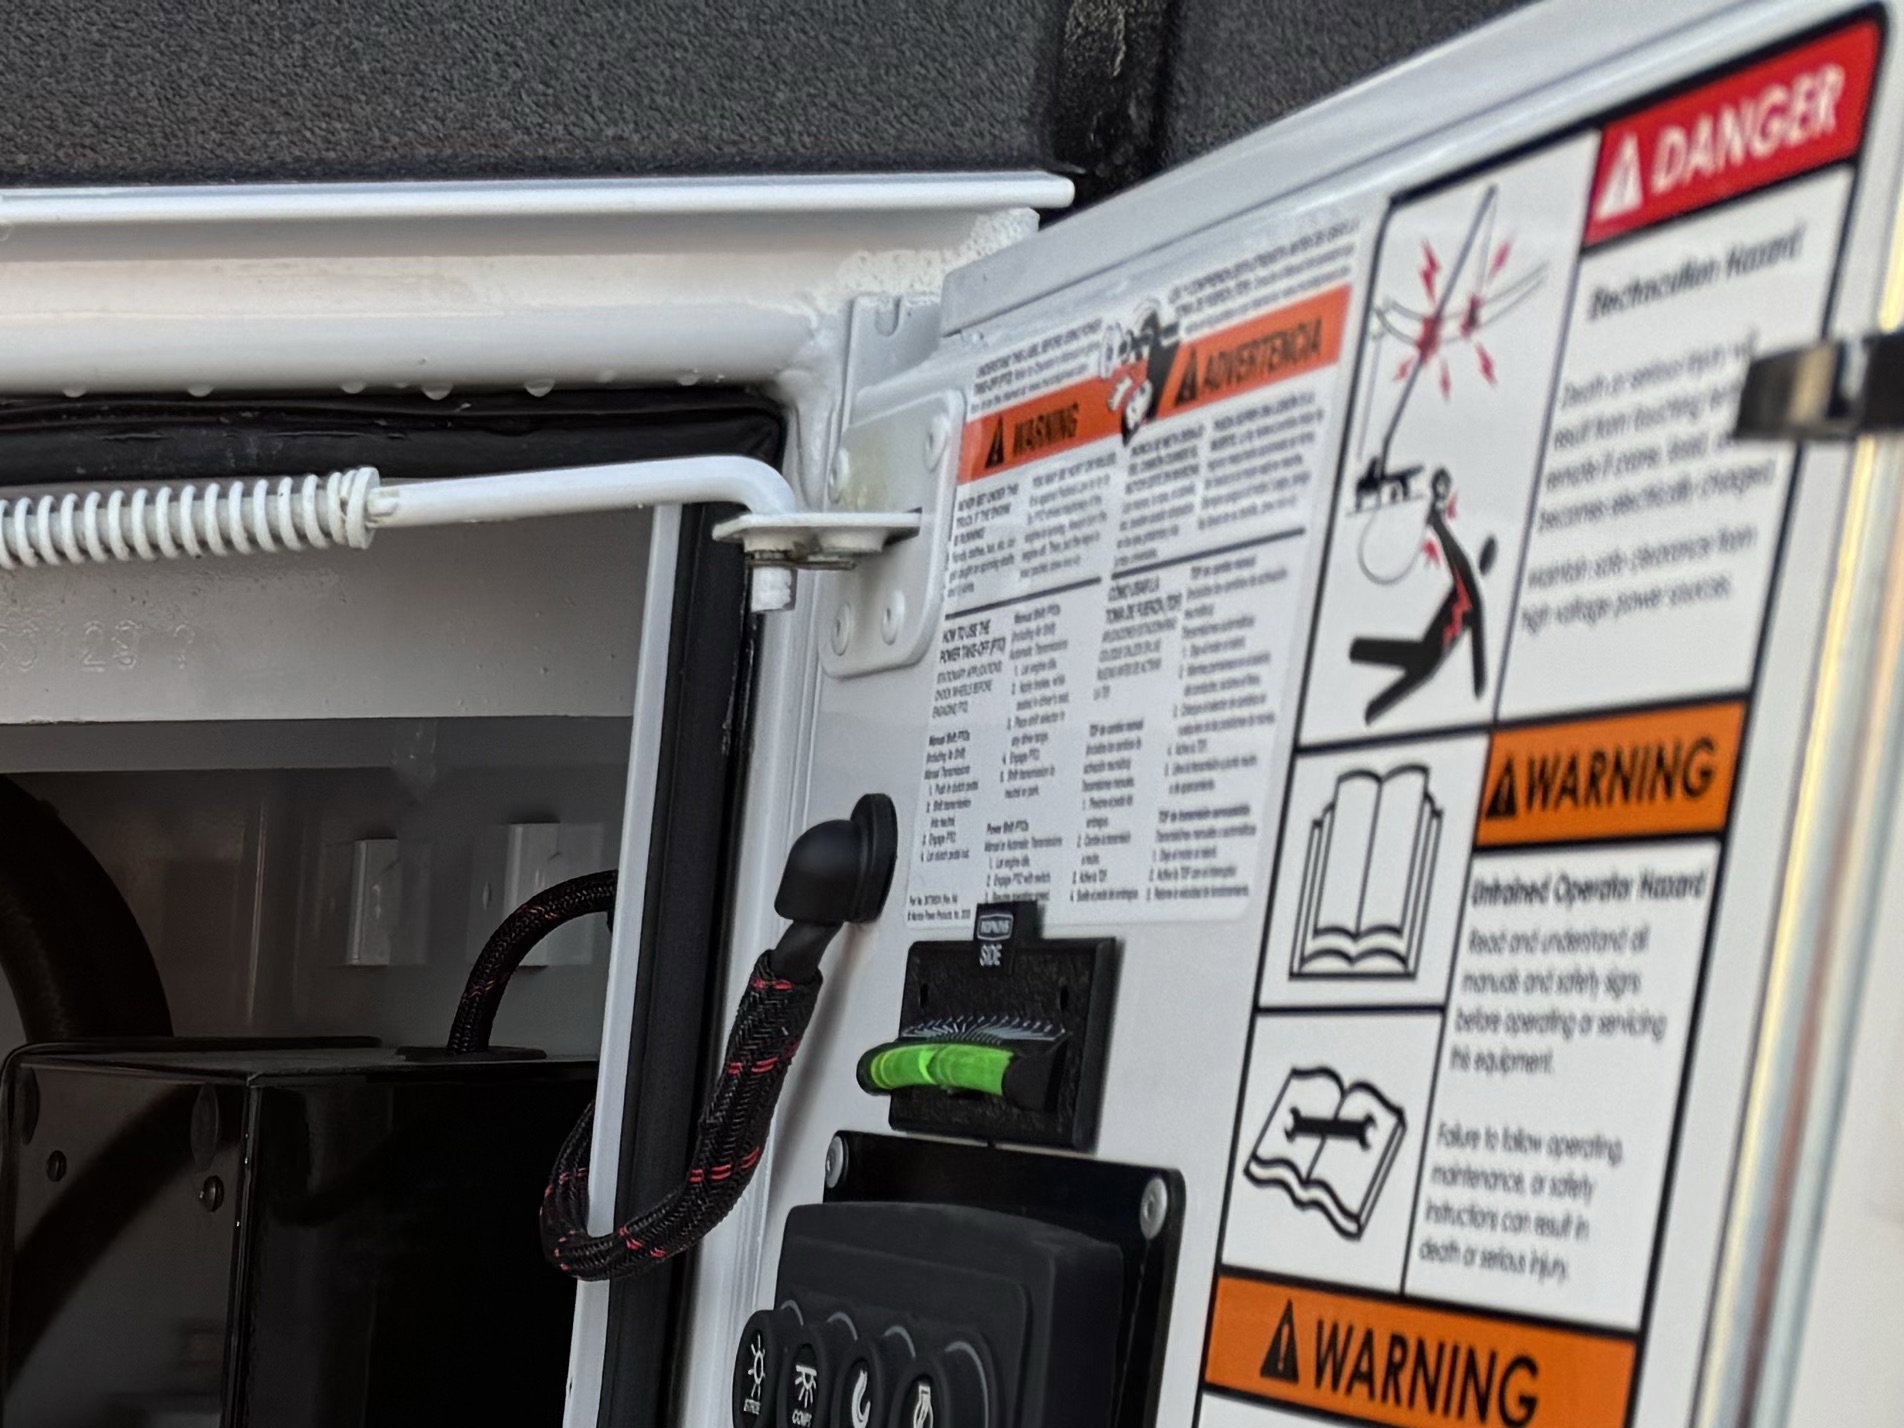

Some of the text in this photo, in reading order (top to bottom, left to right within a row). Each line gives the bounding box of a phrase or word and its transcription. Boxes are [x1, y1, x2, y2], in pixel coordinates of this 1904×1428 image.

[1649, 62, 1845, 194] DANGER
[1202, 318, 1322, 394] ADVERTENCIA
[1012, 405, 1080, 458] WARNING
[1525, 736, 1718, 814] WARNING
[1554, 872, 1633, 905] Operator
[1638, 870, 1706, 900] Hazard
[980, 944, 1002, 966] SIDE
[1437, 1122, 1480, 1151] Failure
[1502, 1126, 1542, 1154] follow
[1550, 1170, 1594, 1201] safety
[1424, 1200, 1589, 1240] instructions can result in
[1420, 1236, 1460, 1266] death
[1463, 1244, 1478, 1267] or
[1482, 1243, 1526, 1275] serious
